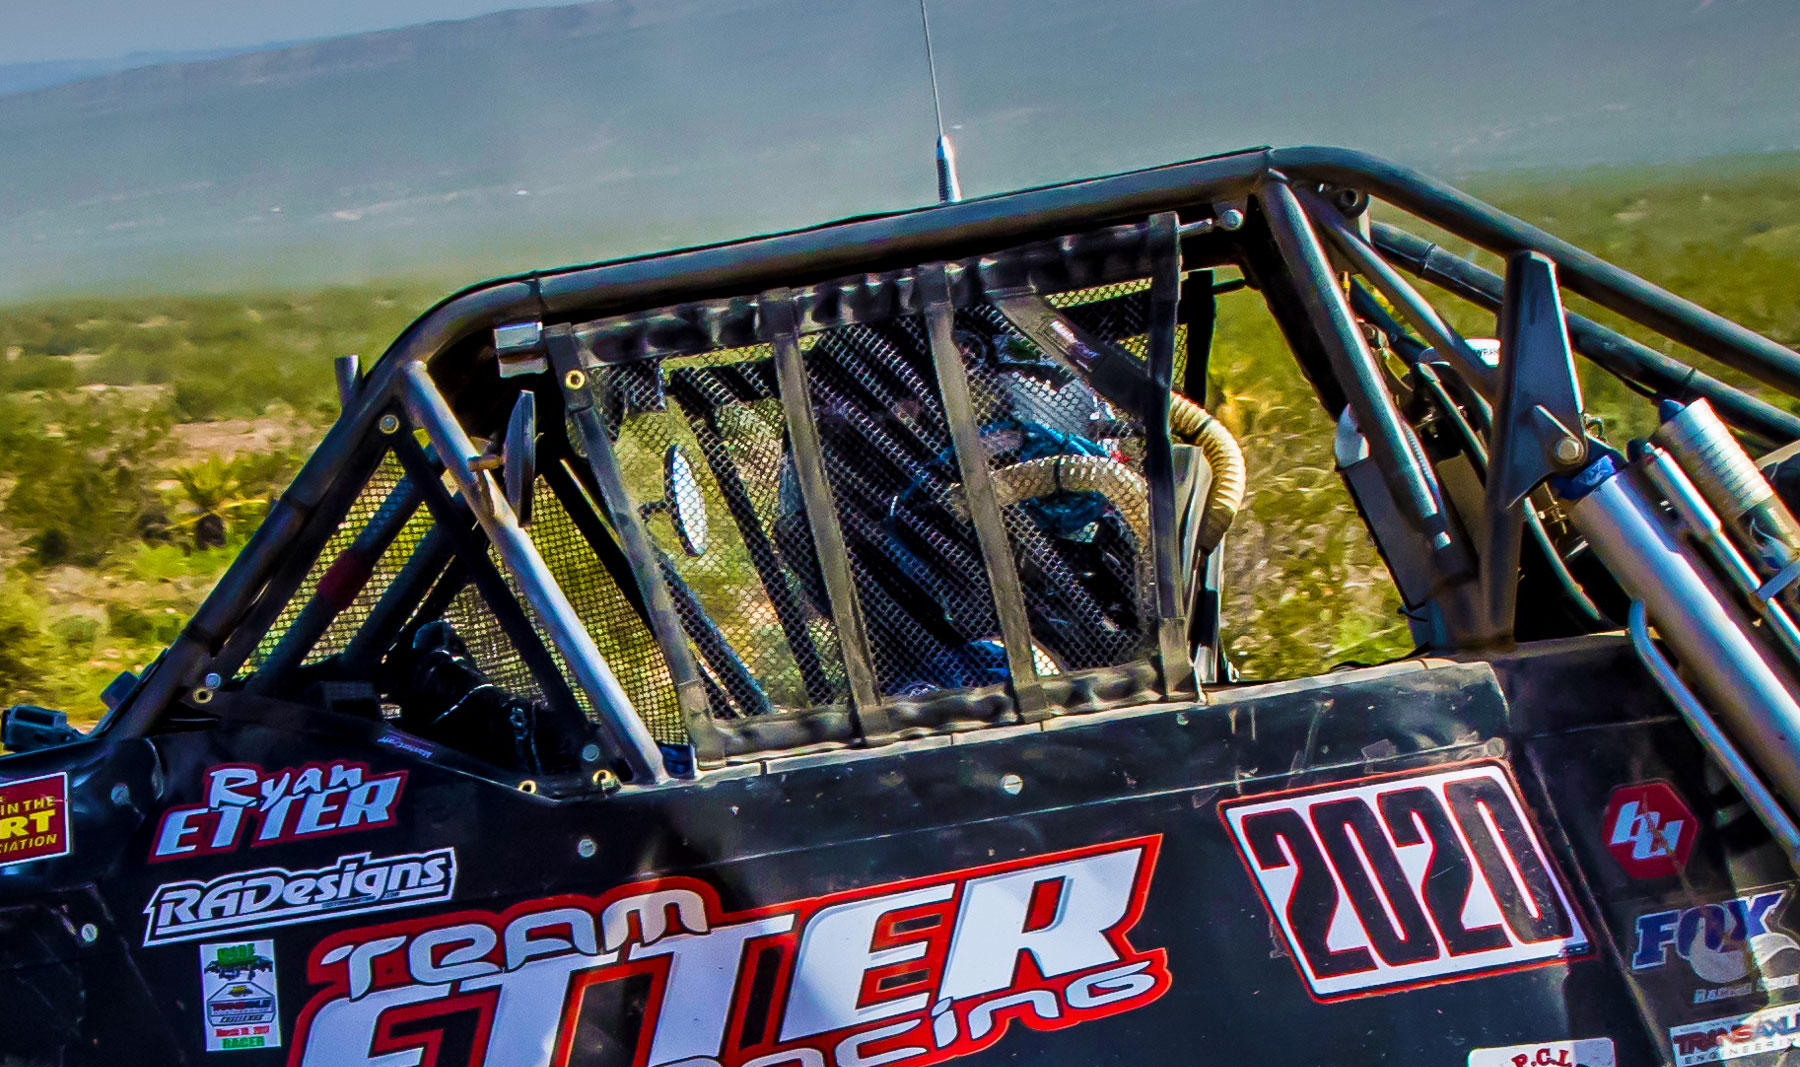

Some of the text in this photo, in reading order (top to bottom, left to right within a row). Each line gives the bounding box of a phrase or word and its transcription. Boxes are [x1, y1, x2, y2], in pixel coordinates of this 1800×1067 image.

[1, 802, 19, 816] IN
[23, 795, 55, 810] THE
[155, 776, 402, 856] ETTER
[210, 764, 363, 812] Ryan
[157, 856, 448, 927] RADesigns
[1240, 777, 1575, 980] 2020
[1632, 889, 1788, 970] FOX
